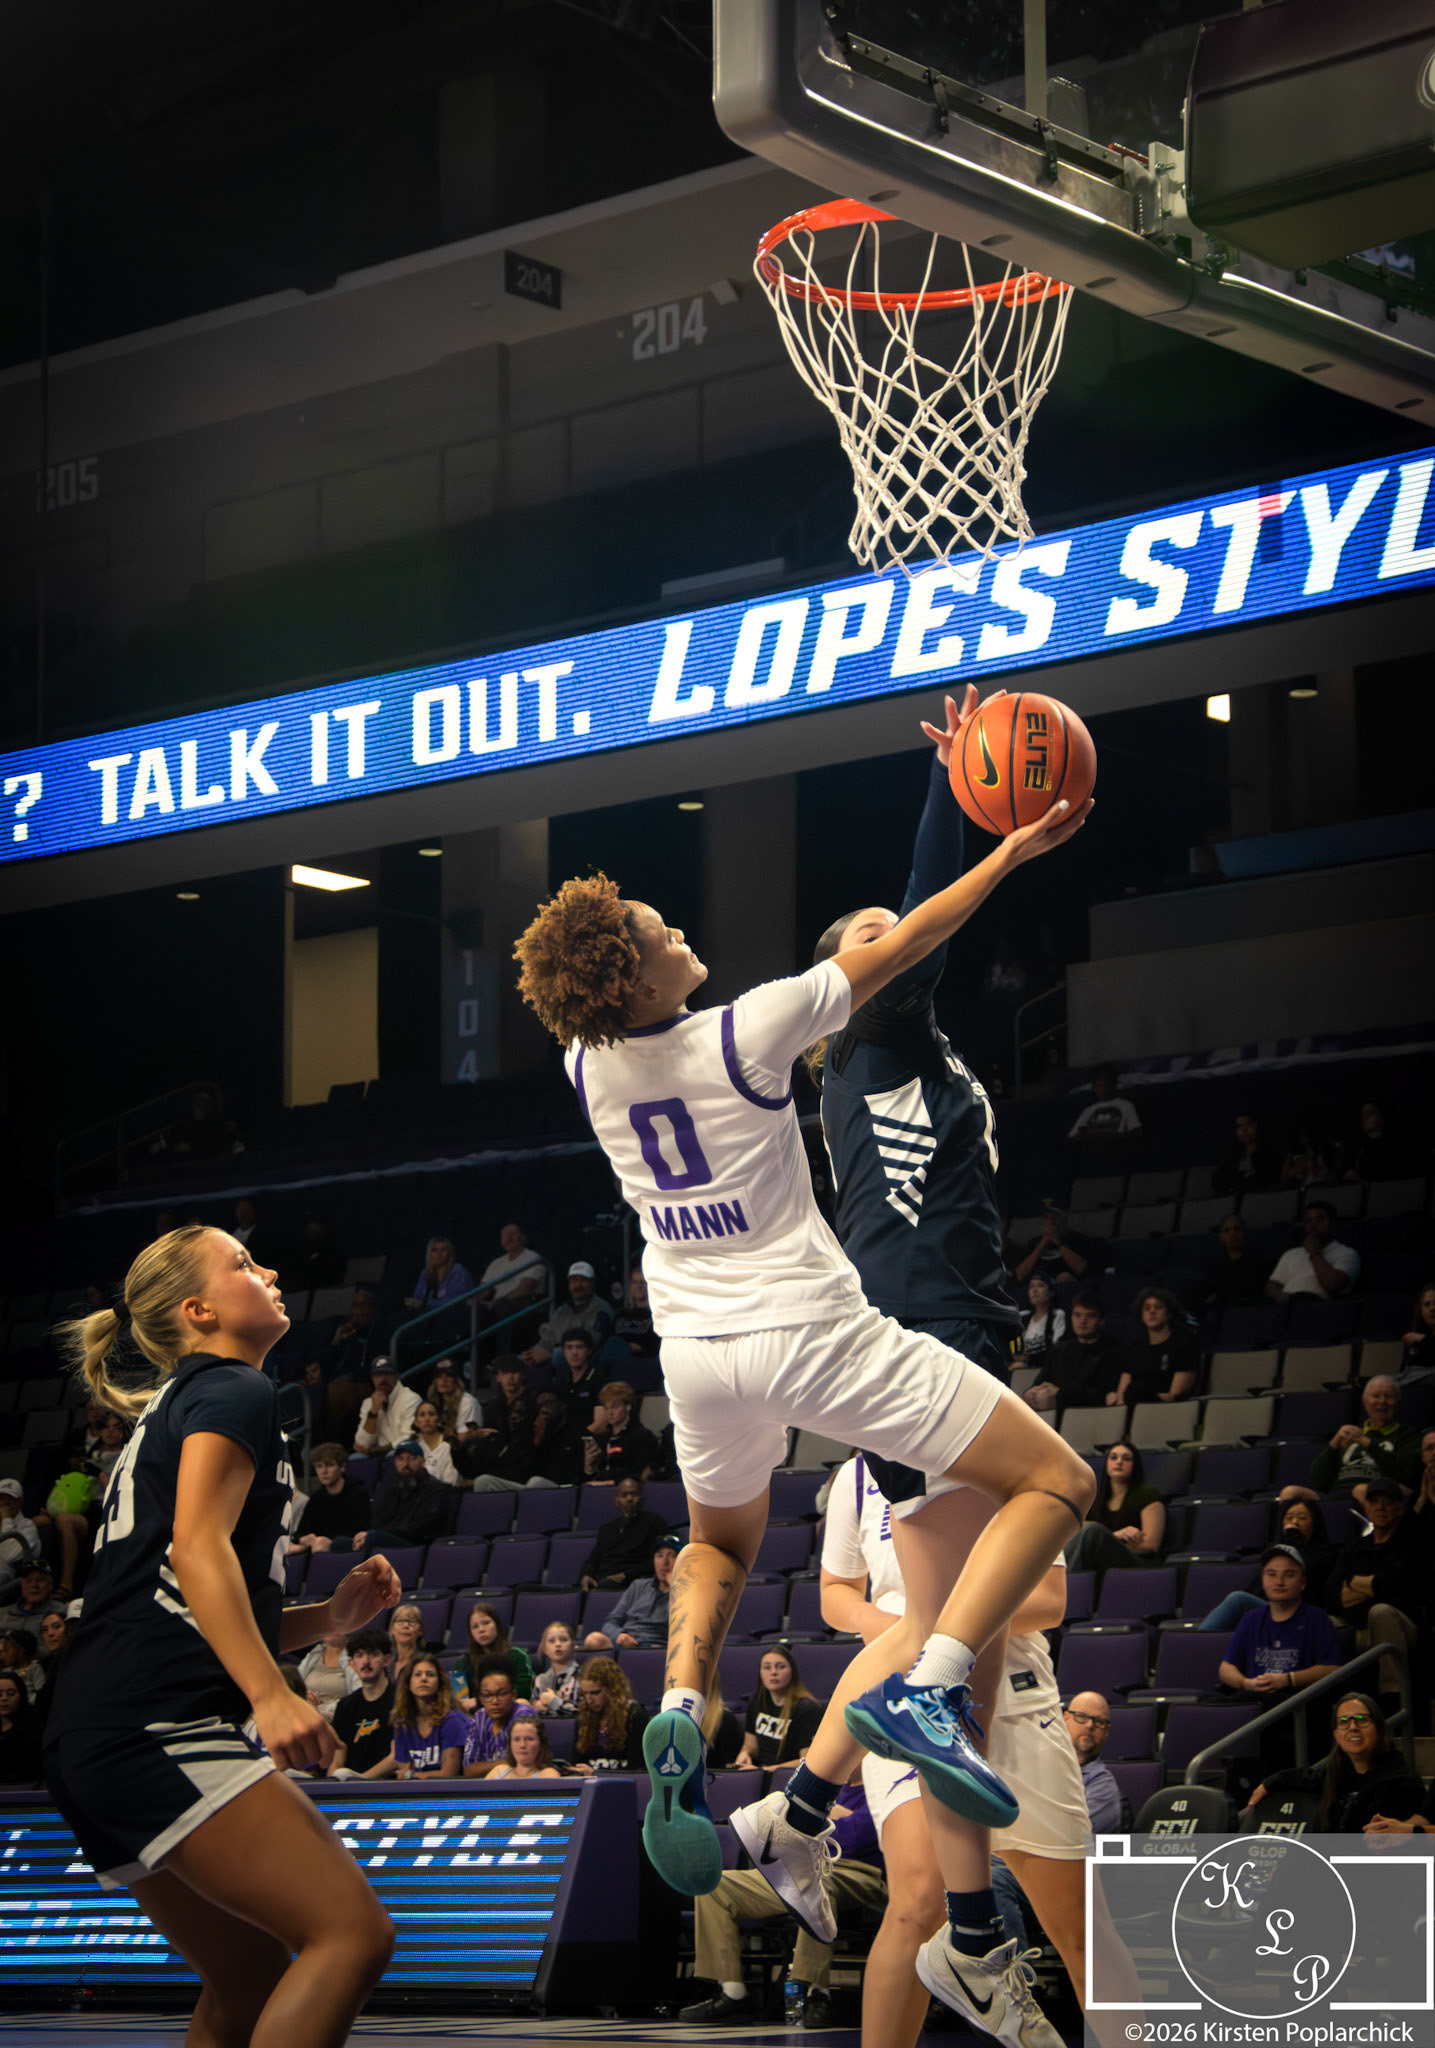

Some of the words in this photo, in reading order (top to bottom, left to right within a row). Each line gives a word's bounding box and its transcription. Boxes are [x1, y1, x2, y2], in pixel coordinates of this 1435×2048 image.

[517, 263, 553, 297] 204
[631, 296, 708, 361] 204
[3, 772, 42, 842] ?
[88, 721, 280, 825] TALK
[310, 700, 381, 787] IT
[411, 660, 591, 766] OUT.
[648, 540, 1072, 722] LOPES
[1104, 457, 1435, 636] STYL
[1023, 712, 1048, 790] ELITE
[629, 1097, 712, 1190] 0
[649, 1199, 750, 1241] MANN
[1170, 1800, 1187, 1812] 40
[1280, 1802, 1294, 1815] 41
[1149, 1818, 1199, 1840] GCU
[1143, 1841, 1197, 1854] GLOBAL
[1248, 1846, 1287, 1858] GLOB
